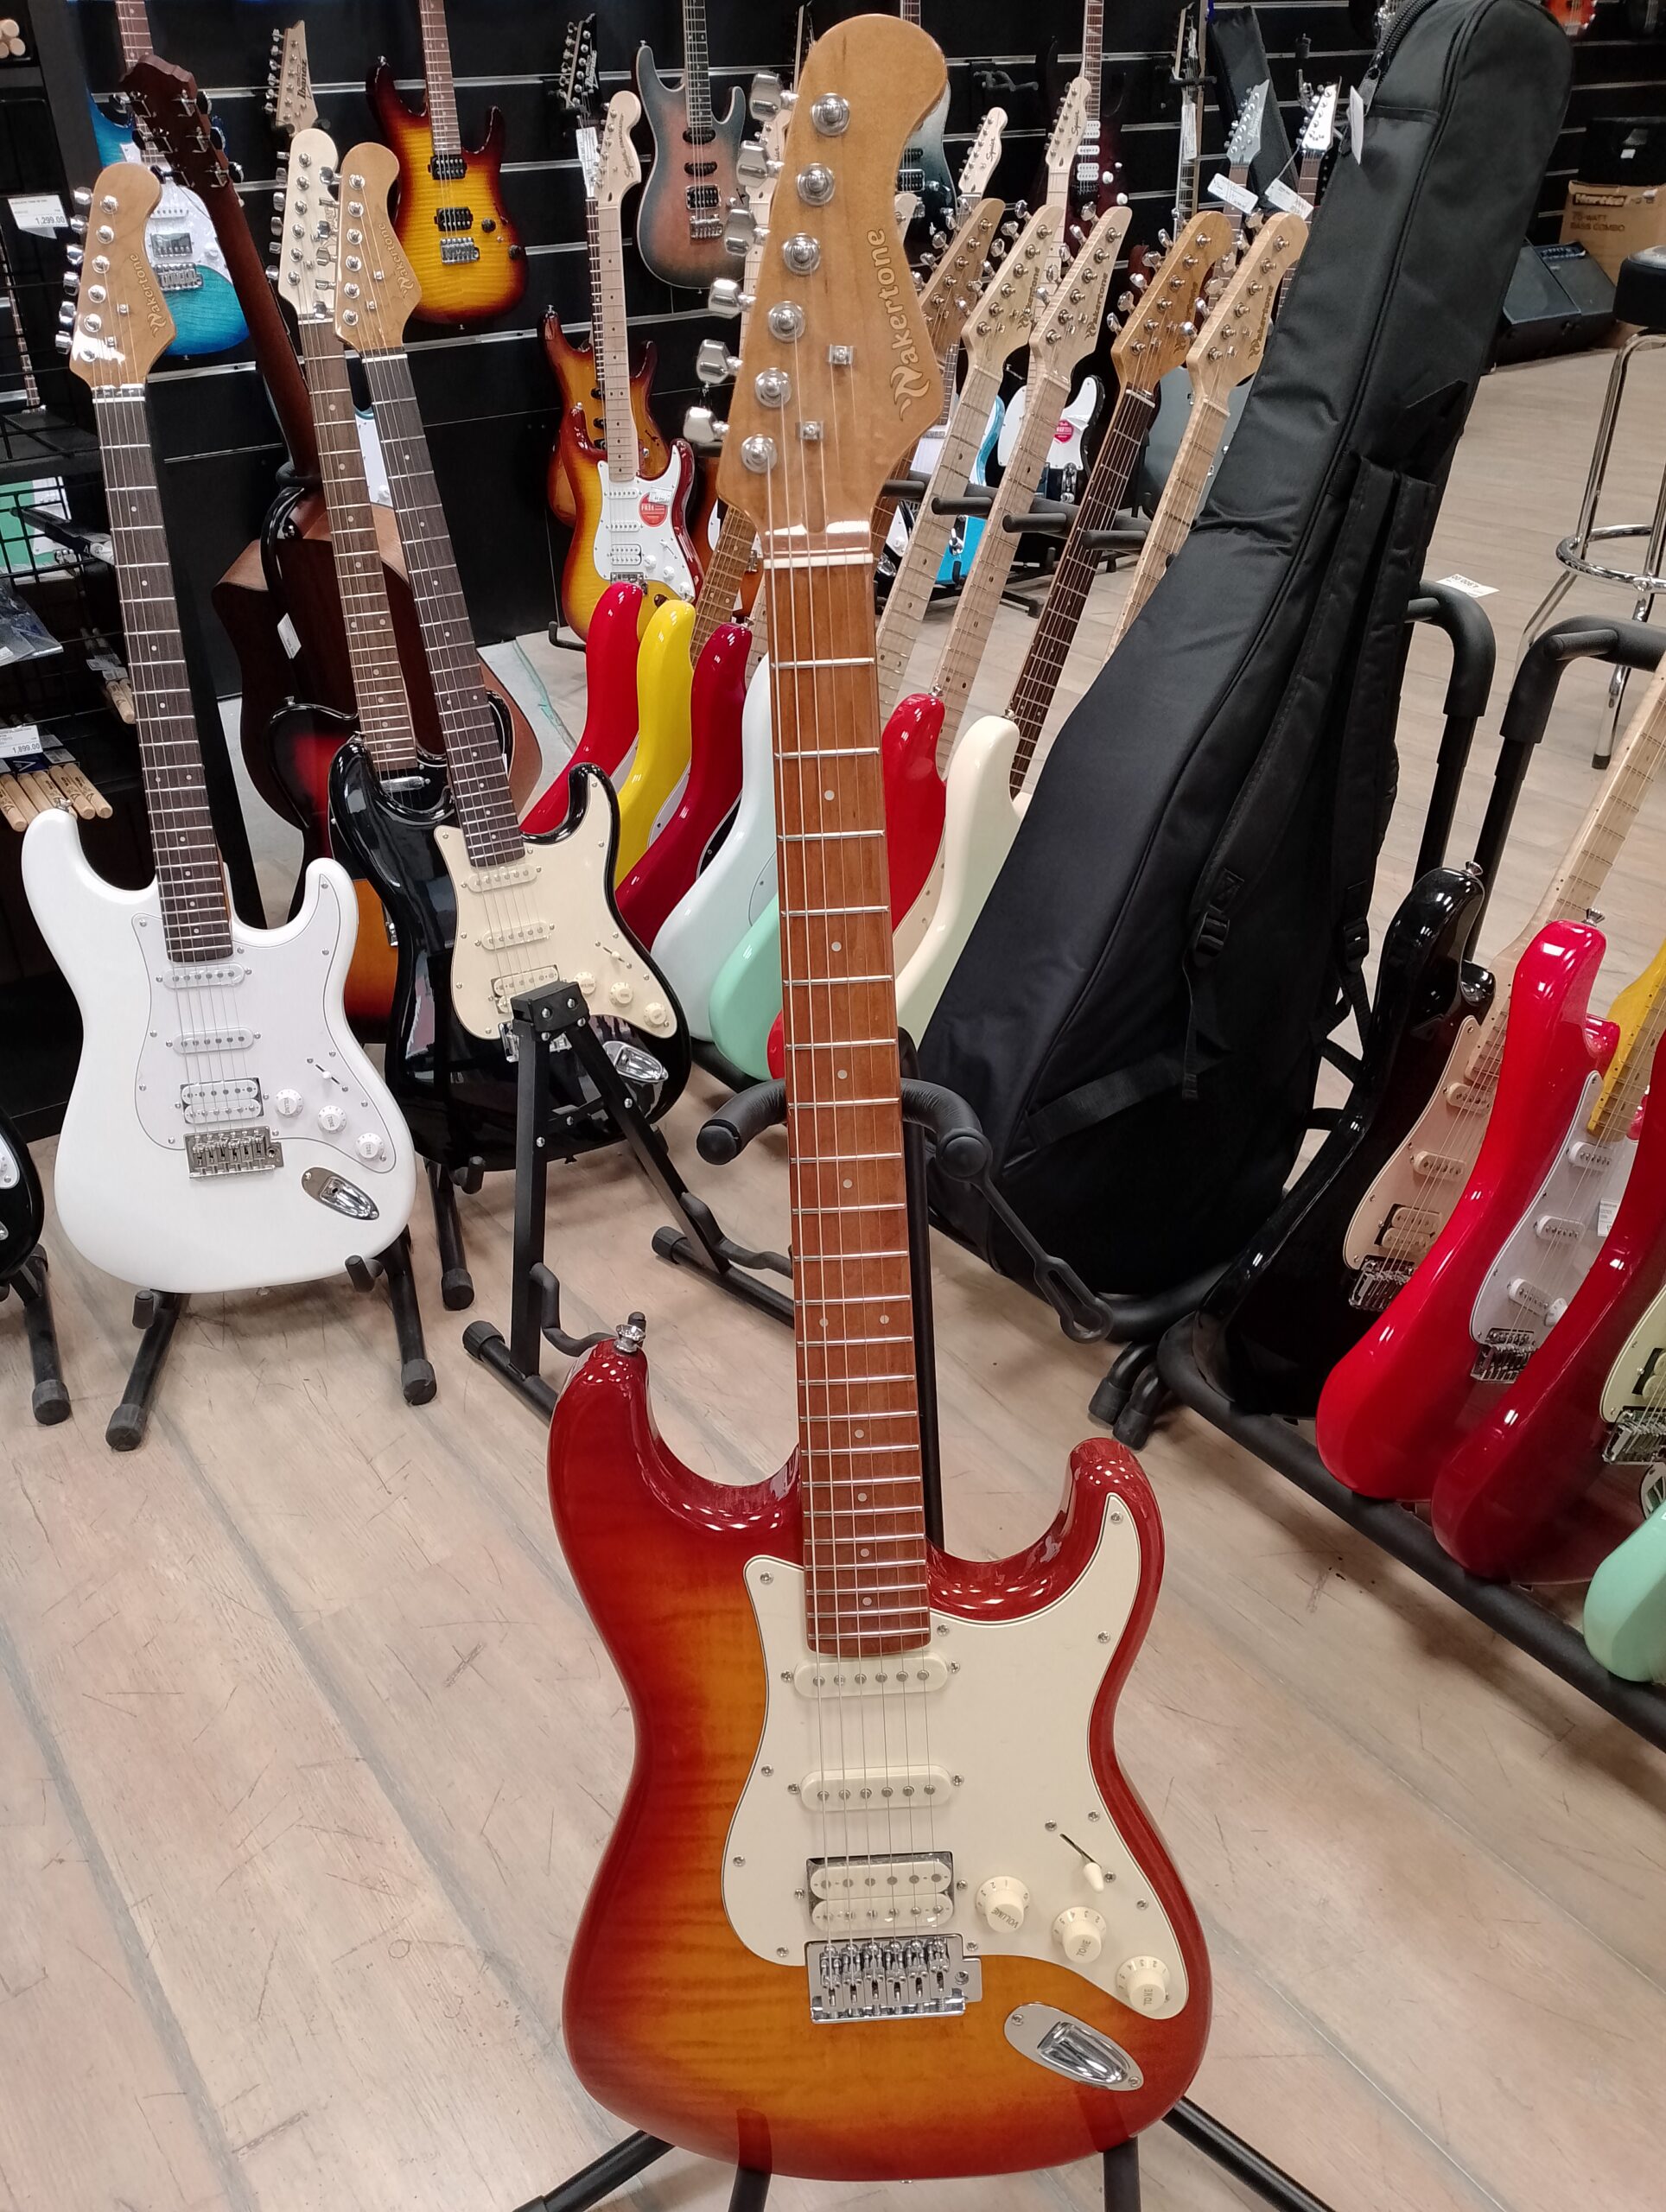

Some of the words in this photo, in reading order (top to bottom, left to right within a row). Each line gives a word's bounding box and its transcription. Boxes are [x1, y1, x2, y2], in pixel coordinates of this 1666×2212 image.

[296, 59, 308, 99] Ibanez
[986, 138, 996, 162] Squier
[12, 742, 41, 753] 1,899.00
[990, 1907, 1020, 1929] VOLUME
[1075, 1939, 1091, 1957] TONE
[1143, 1988, 1154, 2006] TONE
